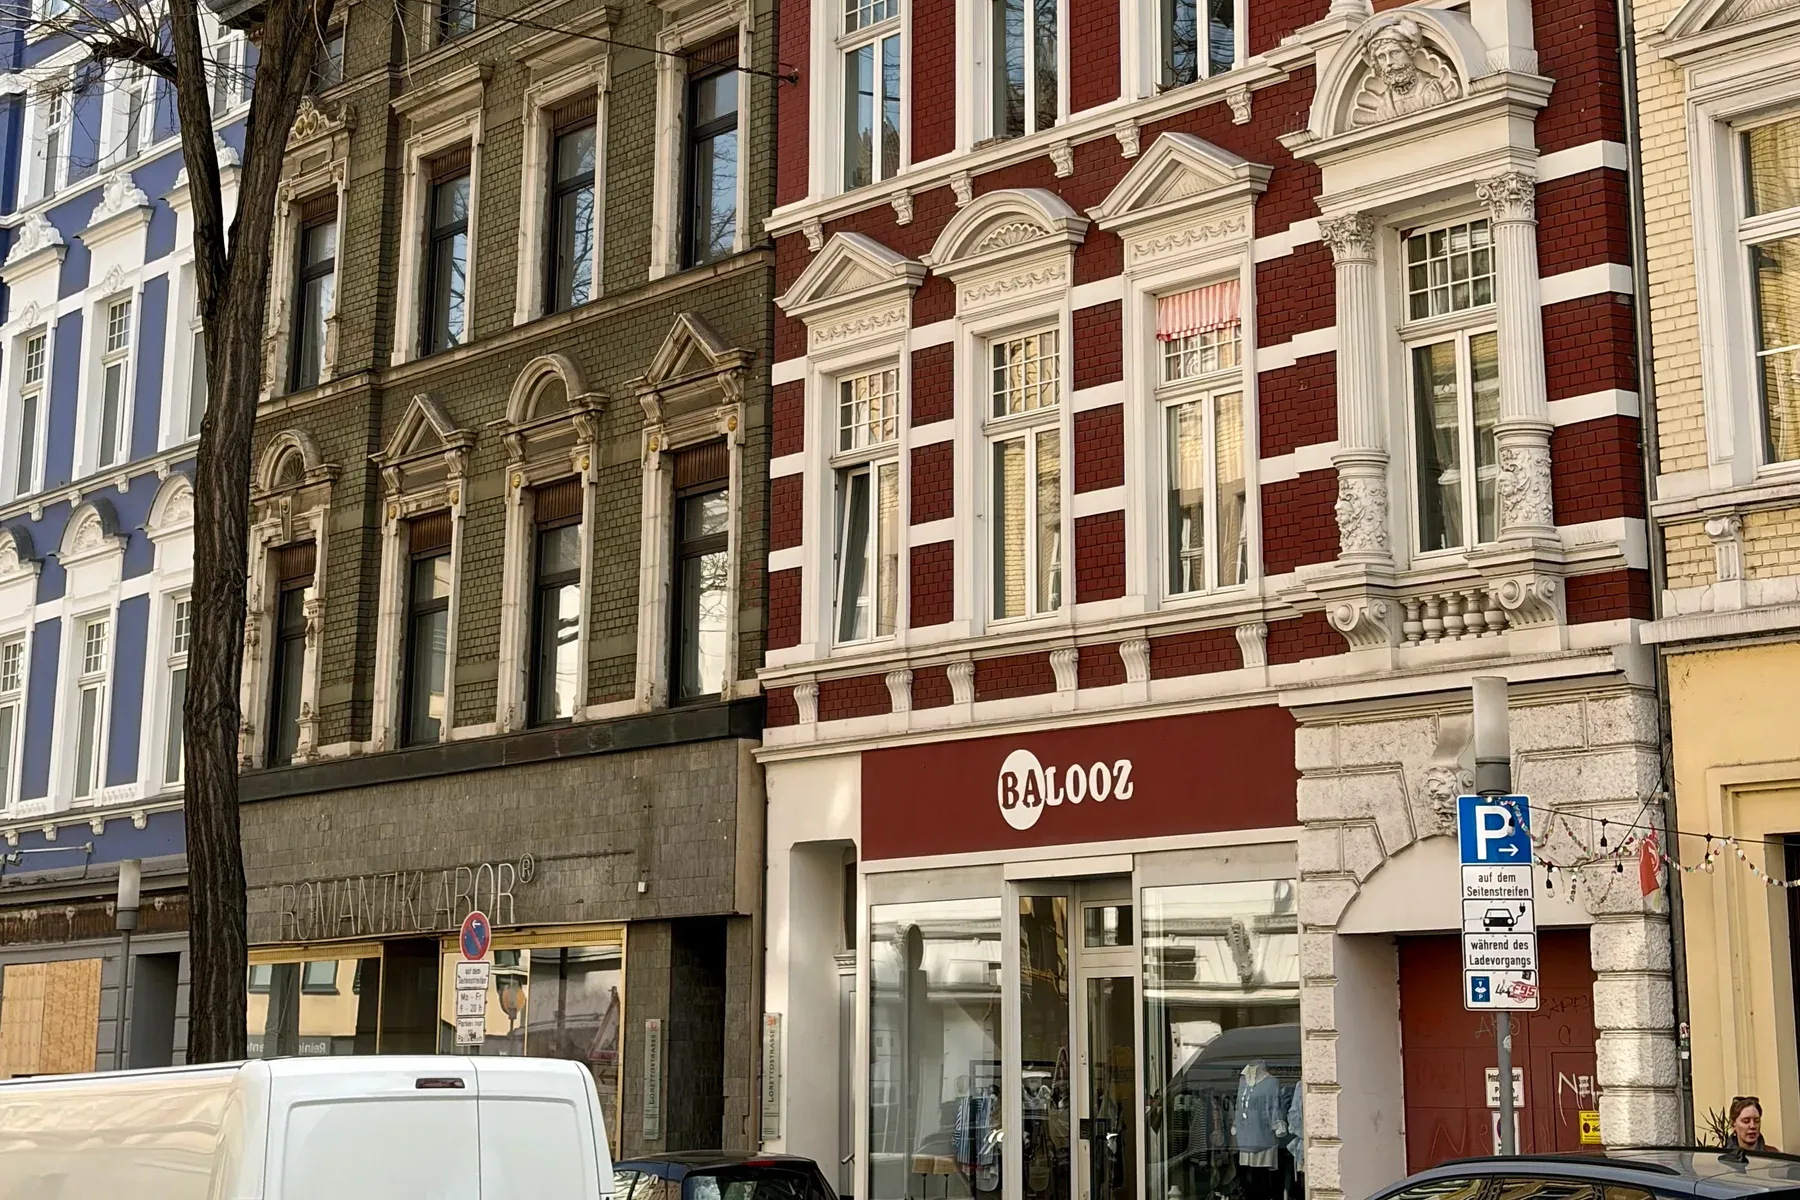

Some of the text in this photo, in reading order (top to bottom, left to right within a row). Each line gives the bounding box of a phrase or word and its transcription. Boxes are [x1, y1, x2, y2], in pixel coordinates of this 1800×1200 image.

[1000, 758, 1135, 811] BALOOZ
[1475, 805, 1513, 860] P
[1478, 872, 1516, 883] auf dem
[1466, 885, 1529, 897] Seitenstreifen
[1470, 939, 1529, 950] während des
[1469, 954, 1532, 969] Ladevorgangs
